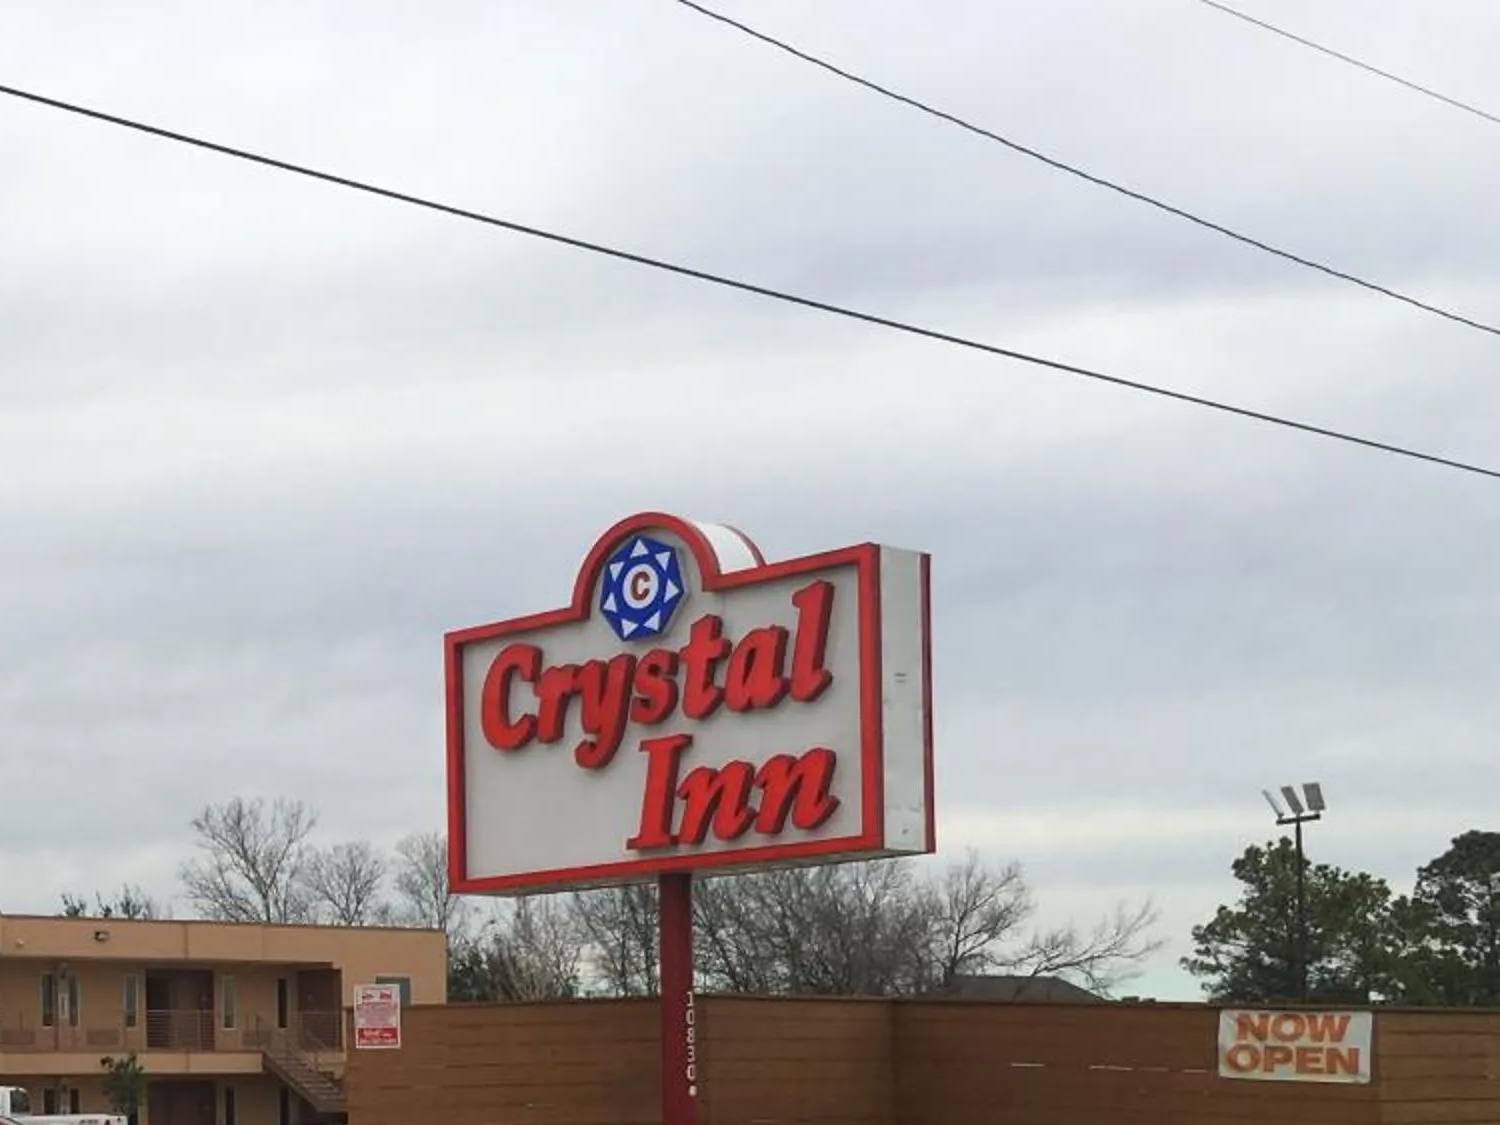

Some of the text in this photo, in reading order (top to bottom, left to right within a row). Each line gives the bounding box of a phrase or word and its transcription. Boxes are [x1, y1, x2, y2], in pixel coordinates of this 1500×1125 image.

[629, 570, 651, 599] C
[482, 579, 835, 770] Crystal
[626, 733, 841, 851] Inn
[1235, 1013, 1352, 1043] NOW
[1225, 1043, 1360, 1075] OPEN
